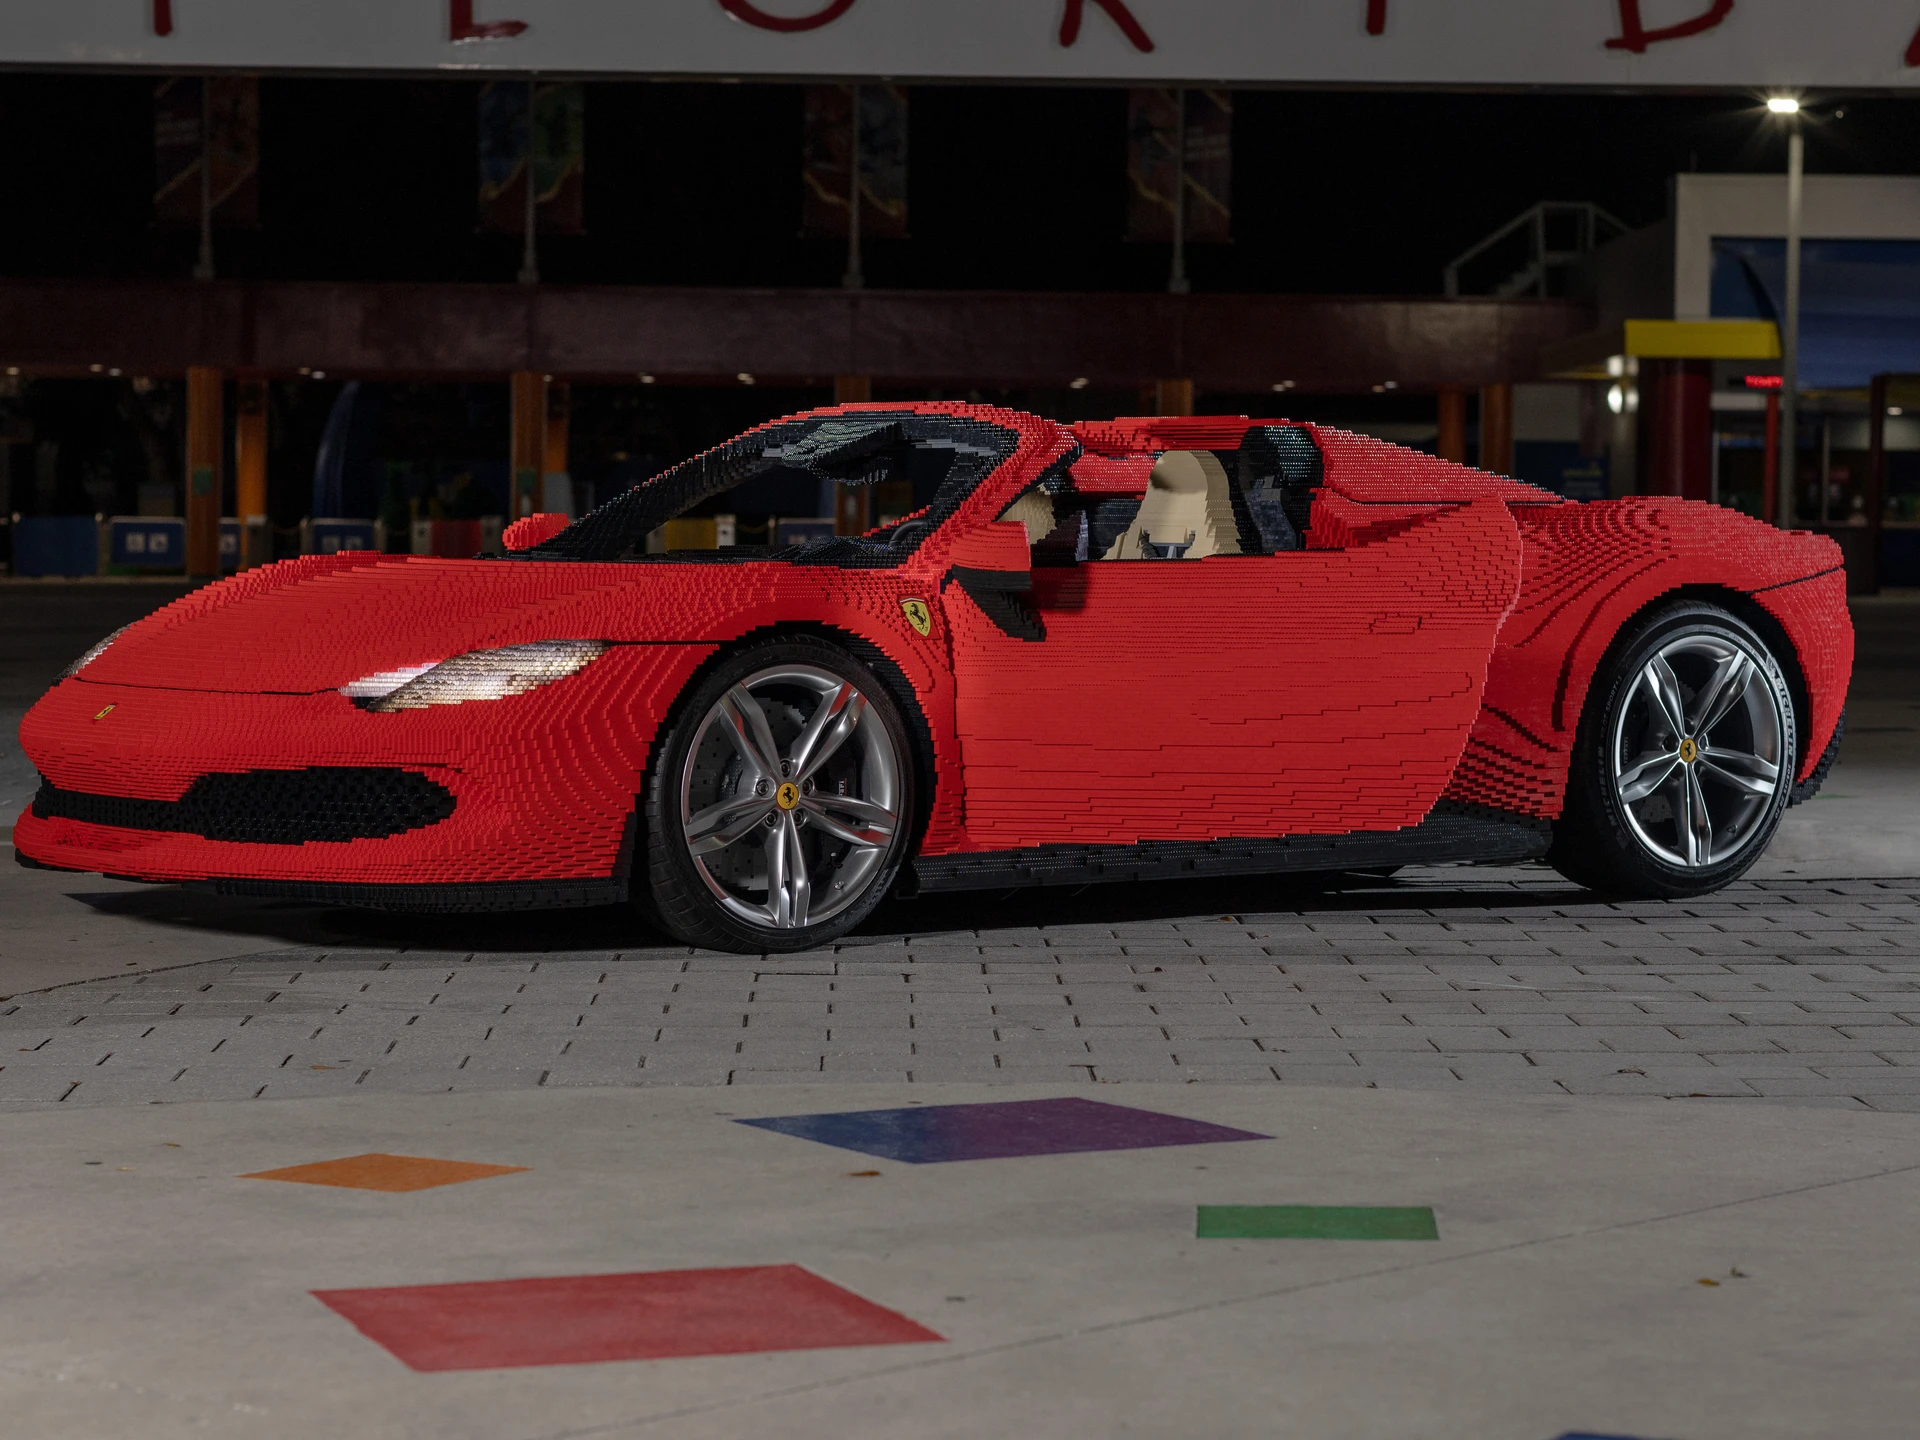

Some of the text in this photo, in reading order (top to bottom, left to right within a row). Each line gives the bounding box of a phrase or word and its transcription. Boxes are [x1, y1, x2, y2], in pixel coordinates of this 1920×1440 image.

[1605, 684, 1619, 712] SPORT
[1775, 676, 1795, 756] MICHELIN
[1597, 747, 1618, 827] MICHELIN
